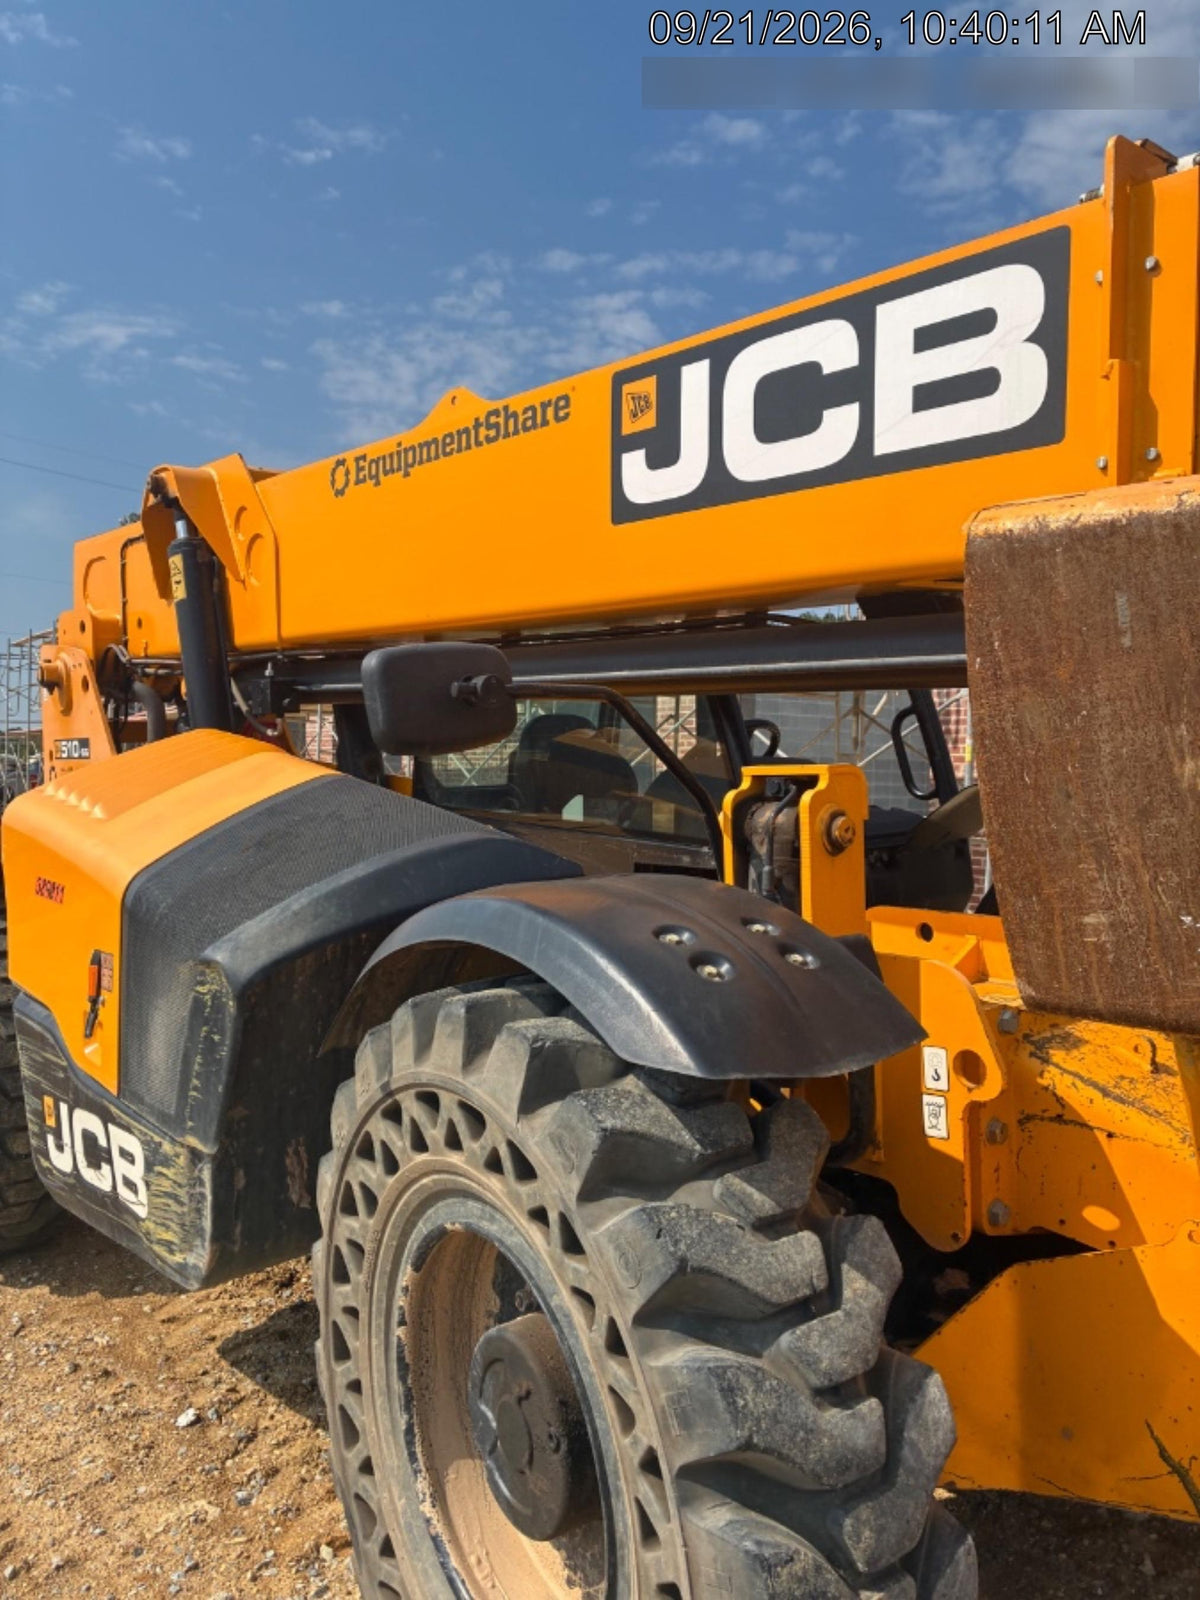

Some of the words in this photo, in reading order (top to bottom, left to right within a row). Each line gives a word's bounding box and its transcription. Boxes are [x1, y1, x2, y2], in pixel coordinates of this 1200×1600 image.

[621, 264, 1049, 504] JCB
[629, 394, 651, 420] JCB
[353, 393, 572, 487] EquipmentShare
[46, 1101, 149, 1219] JCB
